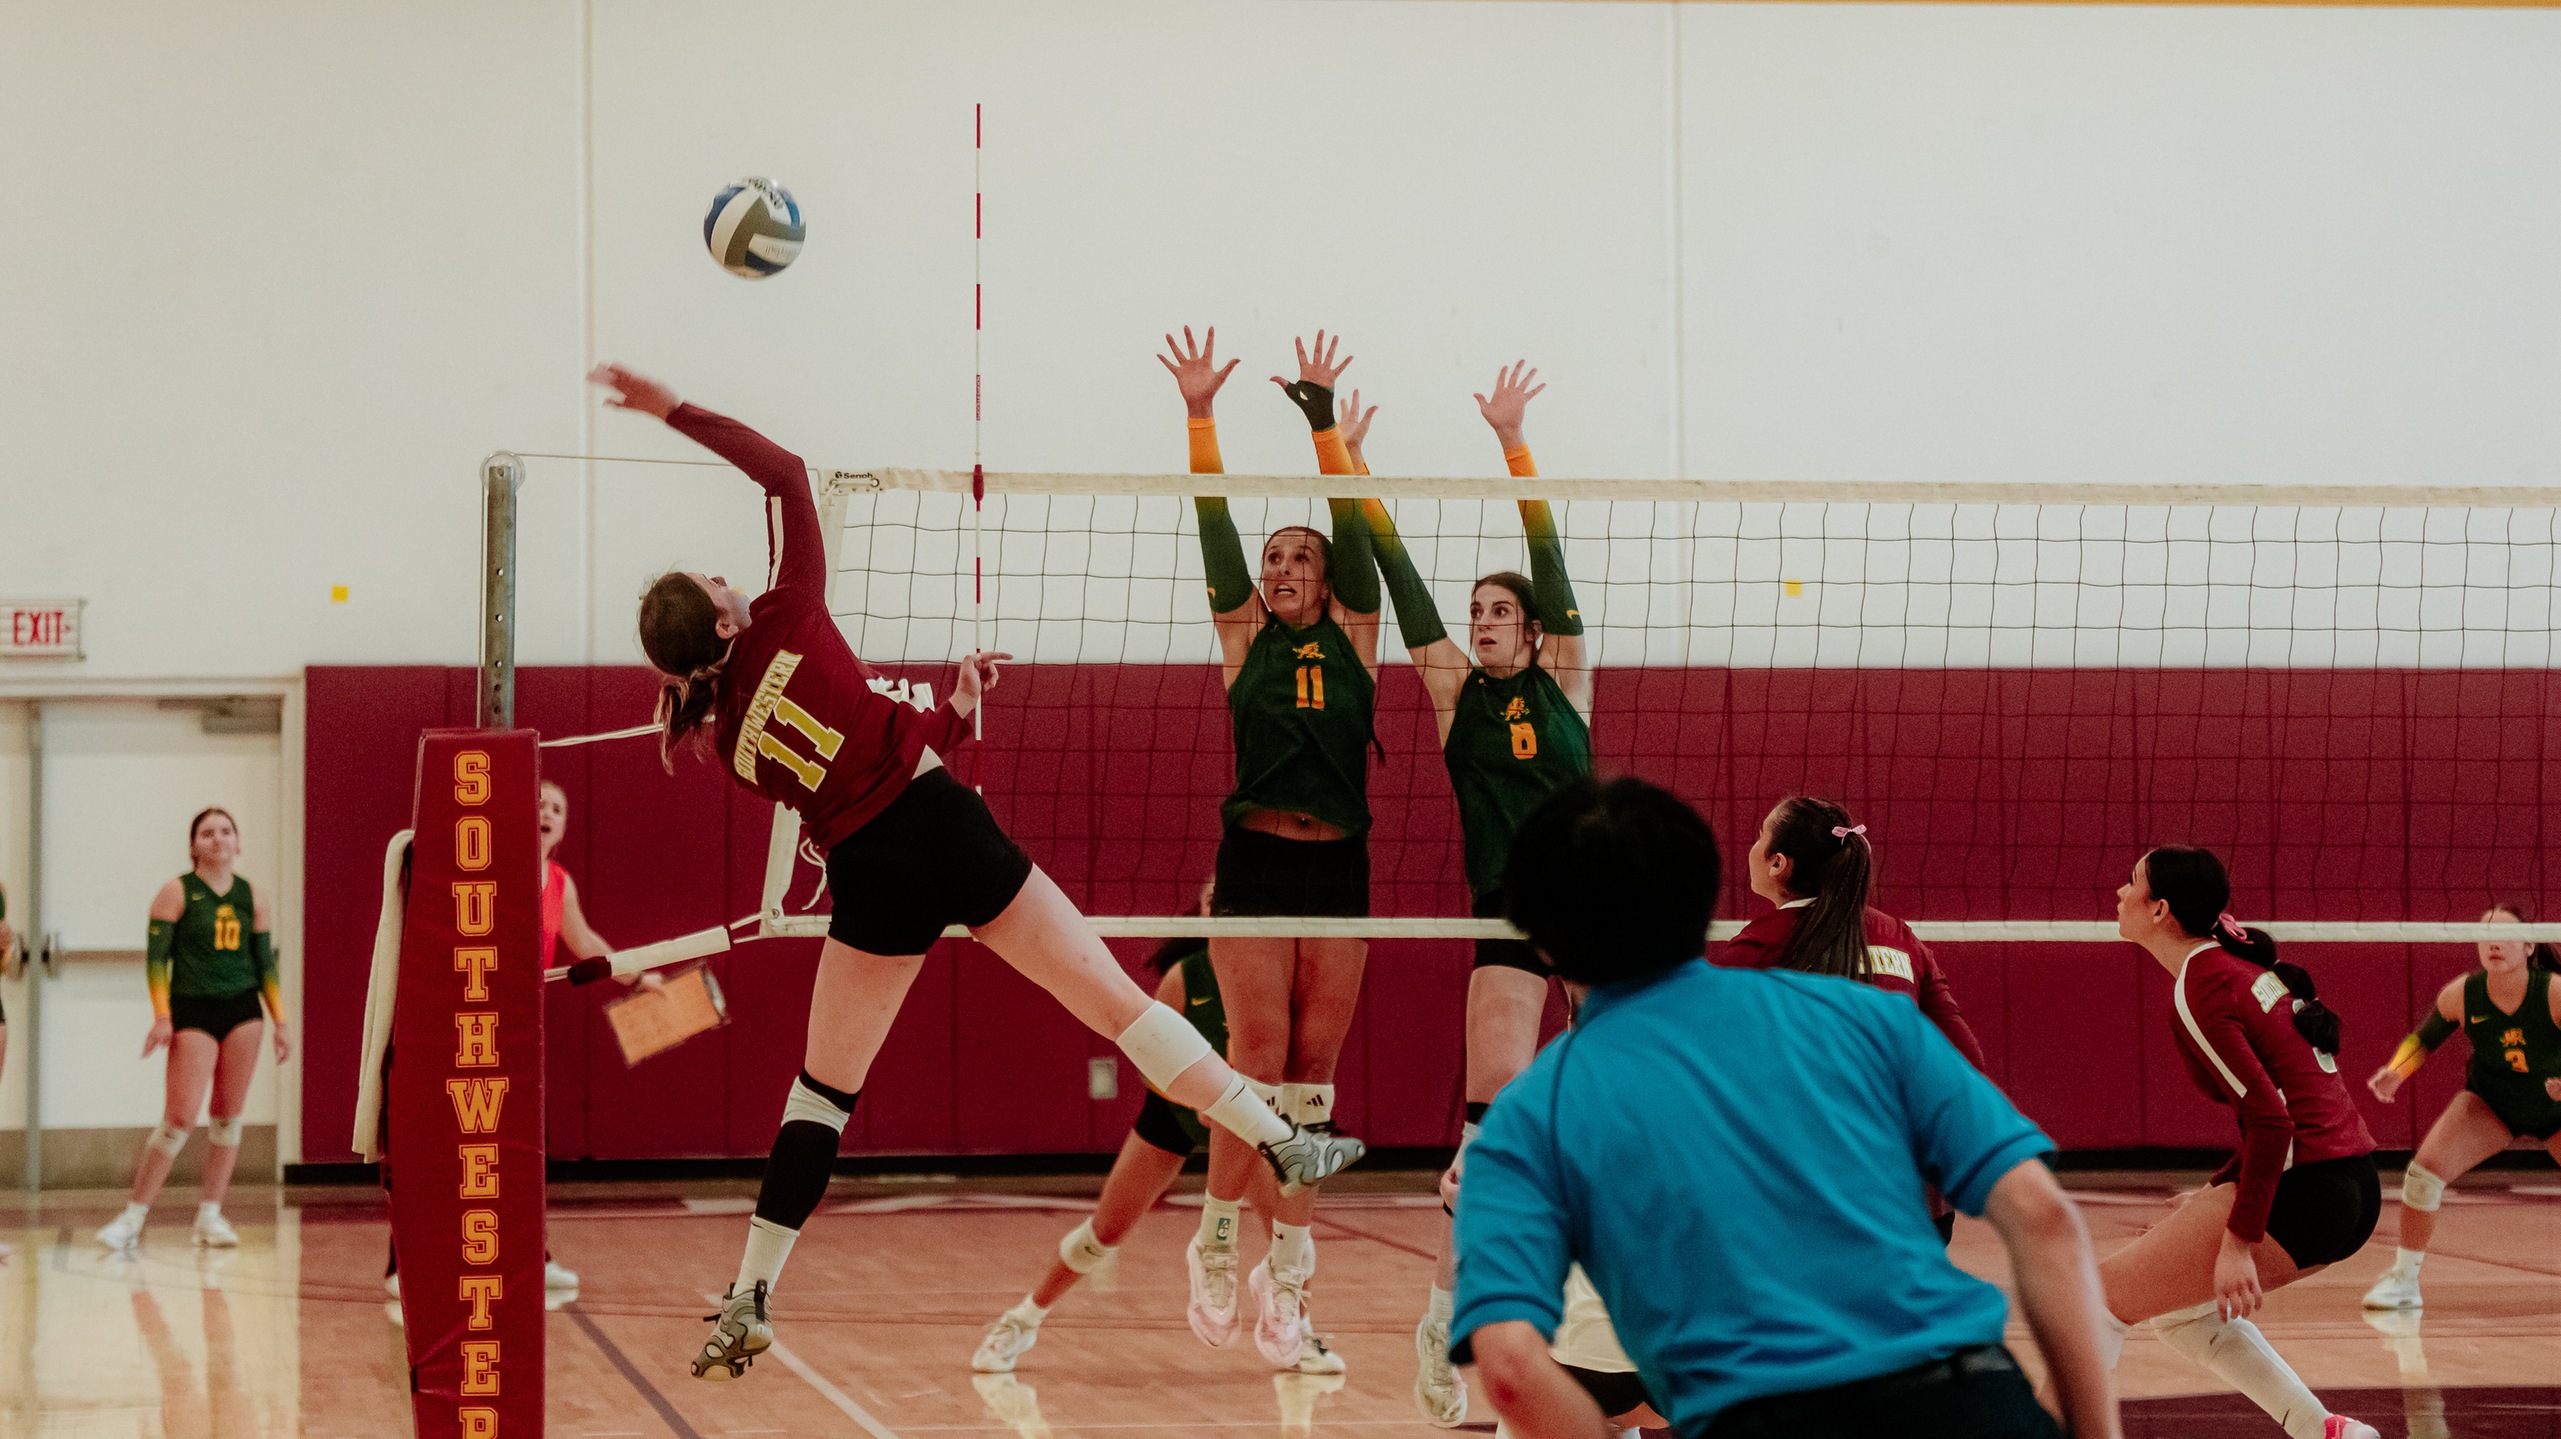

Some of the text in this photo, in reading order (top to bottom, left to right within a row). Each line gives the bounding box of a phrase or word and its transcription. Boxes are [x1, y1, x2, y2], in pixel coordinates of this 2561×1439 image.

[843, 472, 873, 480] Senoh
[13, 610, 63, 646] EXIT
[1296, 665, 1325, 711] 11
[733, 649, 803, 786] SOUTHWESTERN
[757, 695, 845, 793] 11
[214, 919, 241, 951] 10
